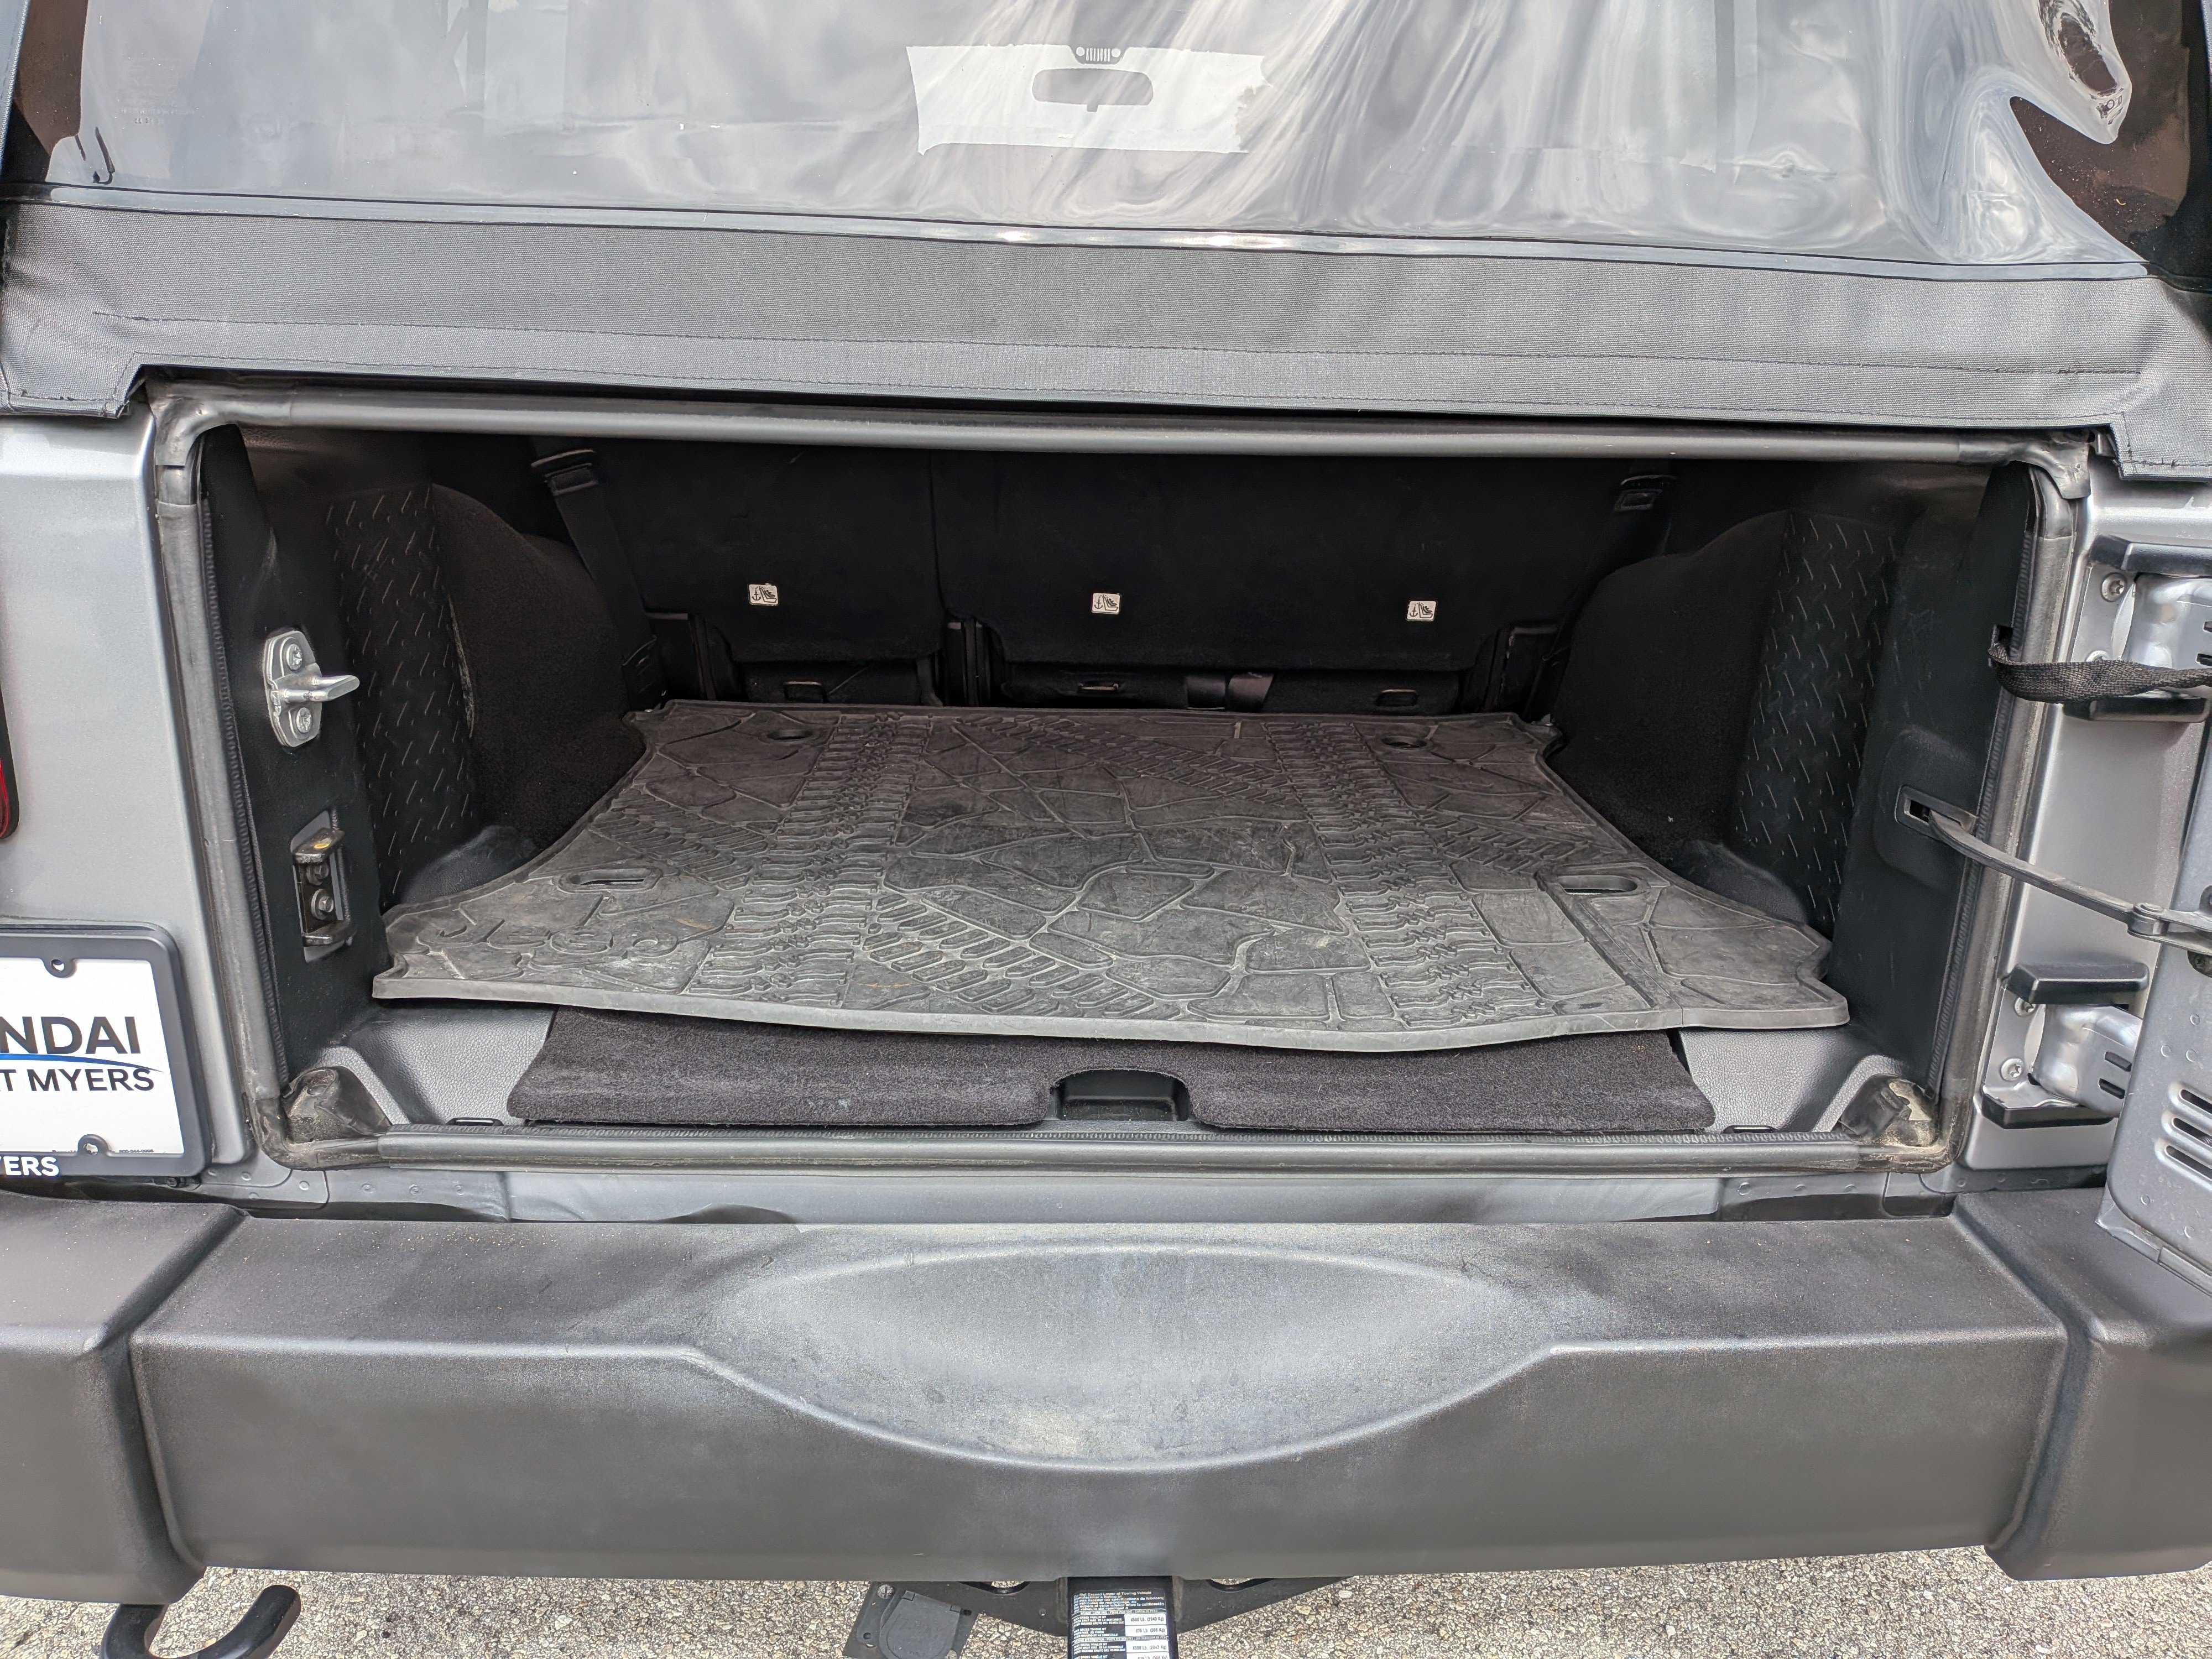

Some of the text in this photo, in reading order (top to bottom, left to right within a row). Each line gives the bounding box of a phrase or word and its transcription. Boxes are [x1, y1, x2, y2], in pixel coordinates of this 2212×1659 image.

[416, 917, 679, 963] Jeep
[0, 1067, 155, 1092] T MYERS
[0, 1156, 60, 1177] ERS
